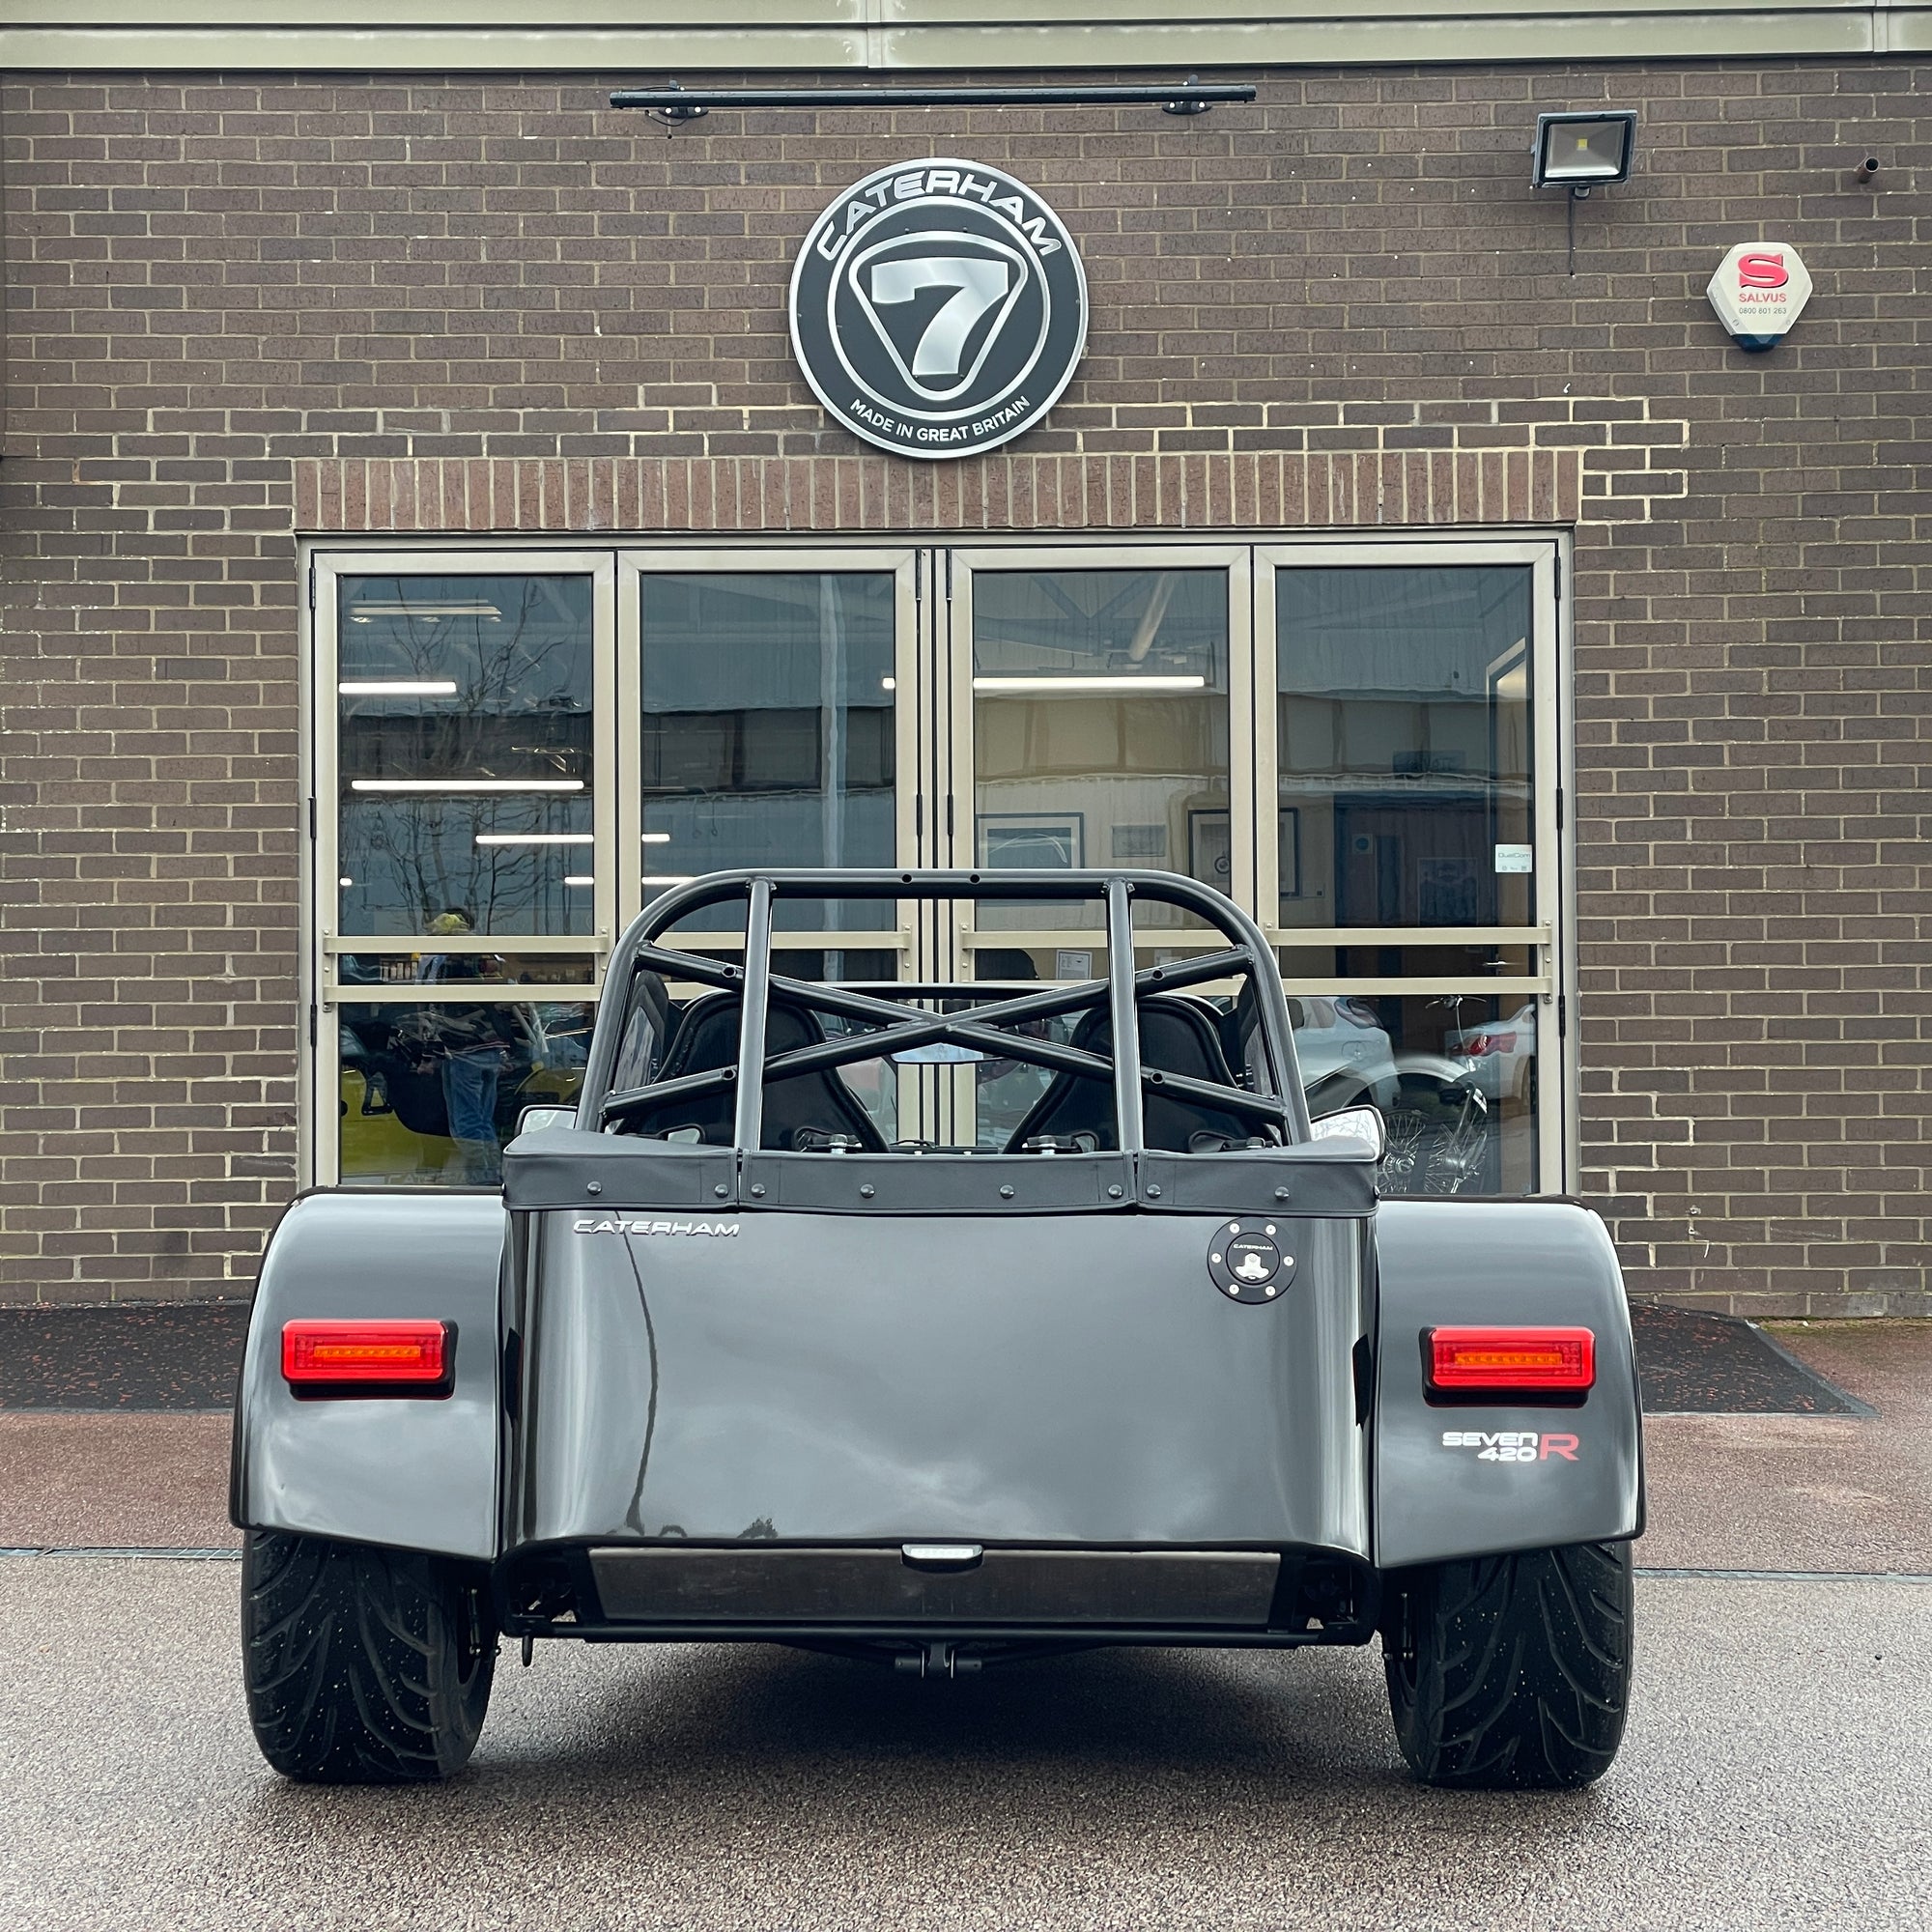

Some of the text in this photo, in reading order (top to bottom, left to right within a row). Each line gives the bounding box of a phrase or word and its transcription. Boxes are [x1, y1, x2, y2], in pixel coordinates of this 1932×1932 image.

[816, 169, 1062, 261] CATERHAM
[1737, 253, 1789, 288] S
[1739, 293, 1787, 303] SALVUS
[871, 256, 1009, 376] 7
[850, 395, 1031, 442] MADE IN GREAT BRITAIN
[573, 1219, 740, 1237] CATERHAM
[1442, 1432, 1579, 1462] SEVEN R
[1477, 1446, 1538, 1462] 420
